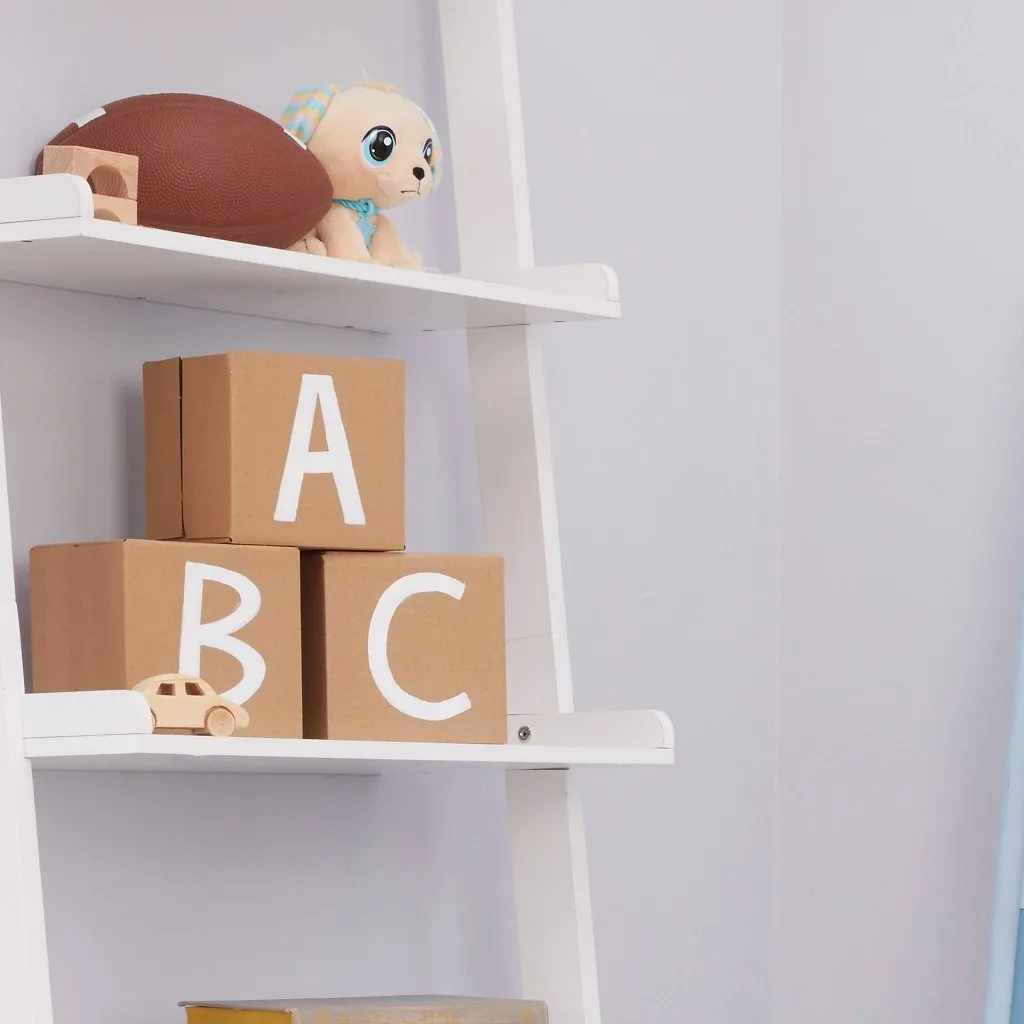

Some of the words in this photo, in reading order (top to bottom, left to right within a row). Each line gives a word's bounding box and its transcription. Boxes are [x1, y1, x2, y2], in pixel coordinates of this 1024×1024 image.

[273, 373, 366, 526] A
[178, 560, 267, 706] B
[367, 571, 472, 721] C
